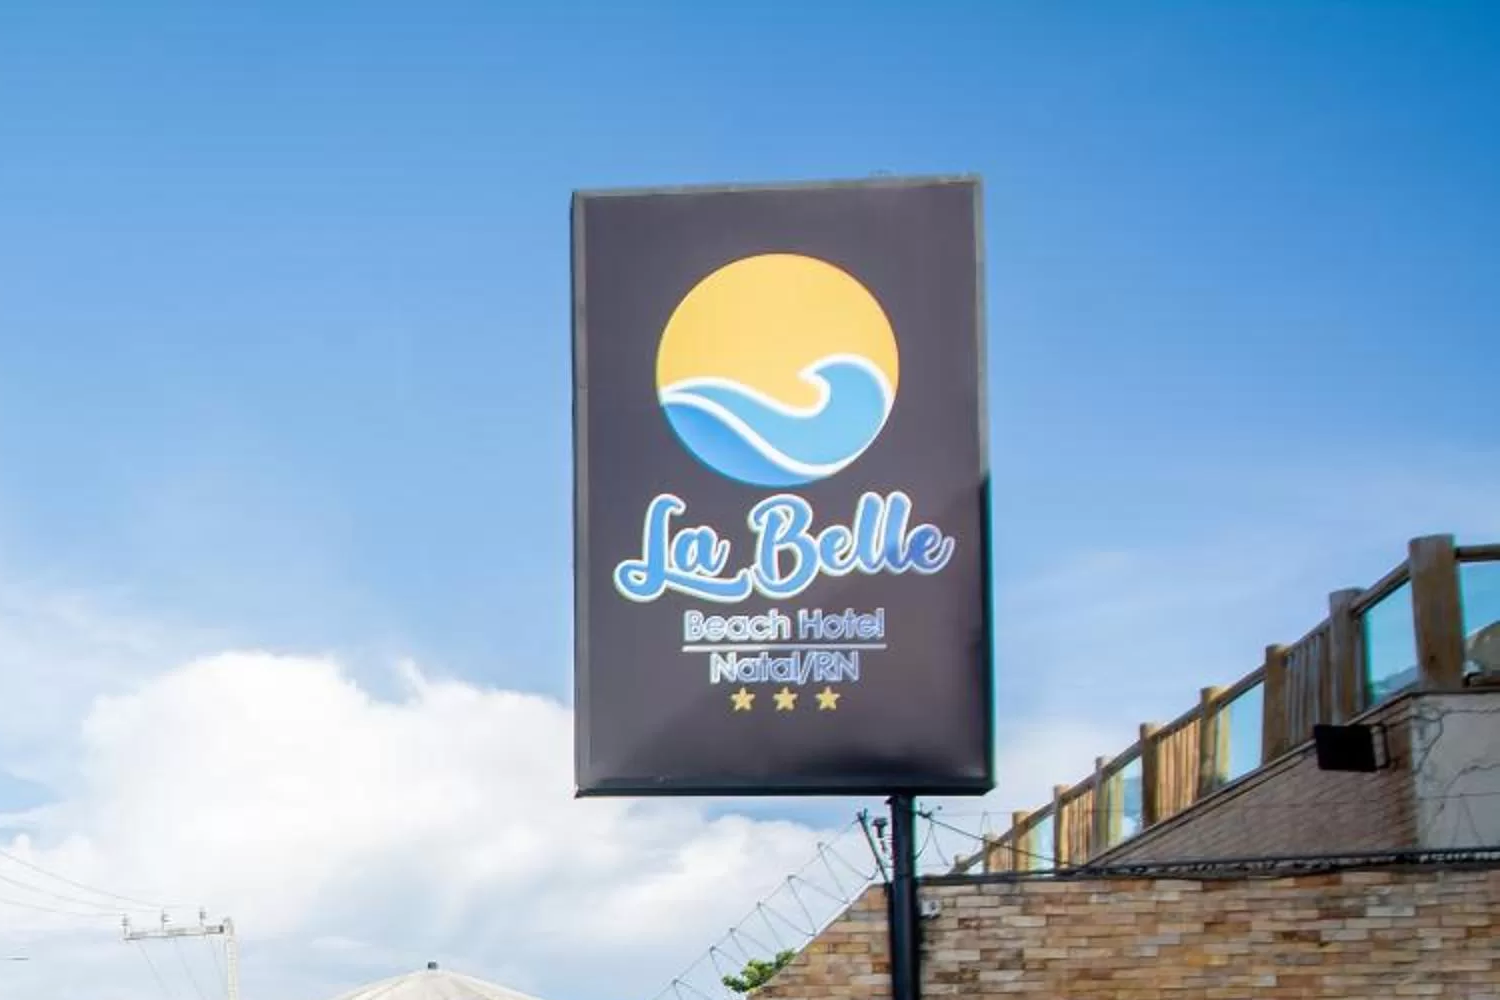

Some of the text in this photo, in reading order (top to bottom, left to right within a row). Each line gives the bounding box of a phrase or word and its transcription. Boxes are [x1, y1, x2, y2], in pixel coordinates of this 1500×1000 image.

[613, 491, 955, 602] La Belle
[682, 607, 886, 641] Beach Hotel
[709, 650, 860, 685] Natal/RN
